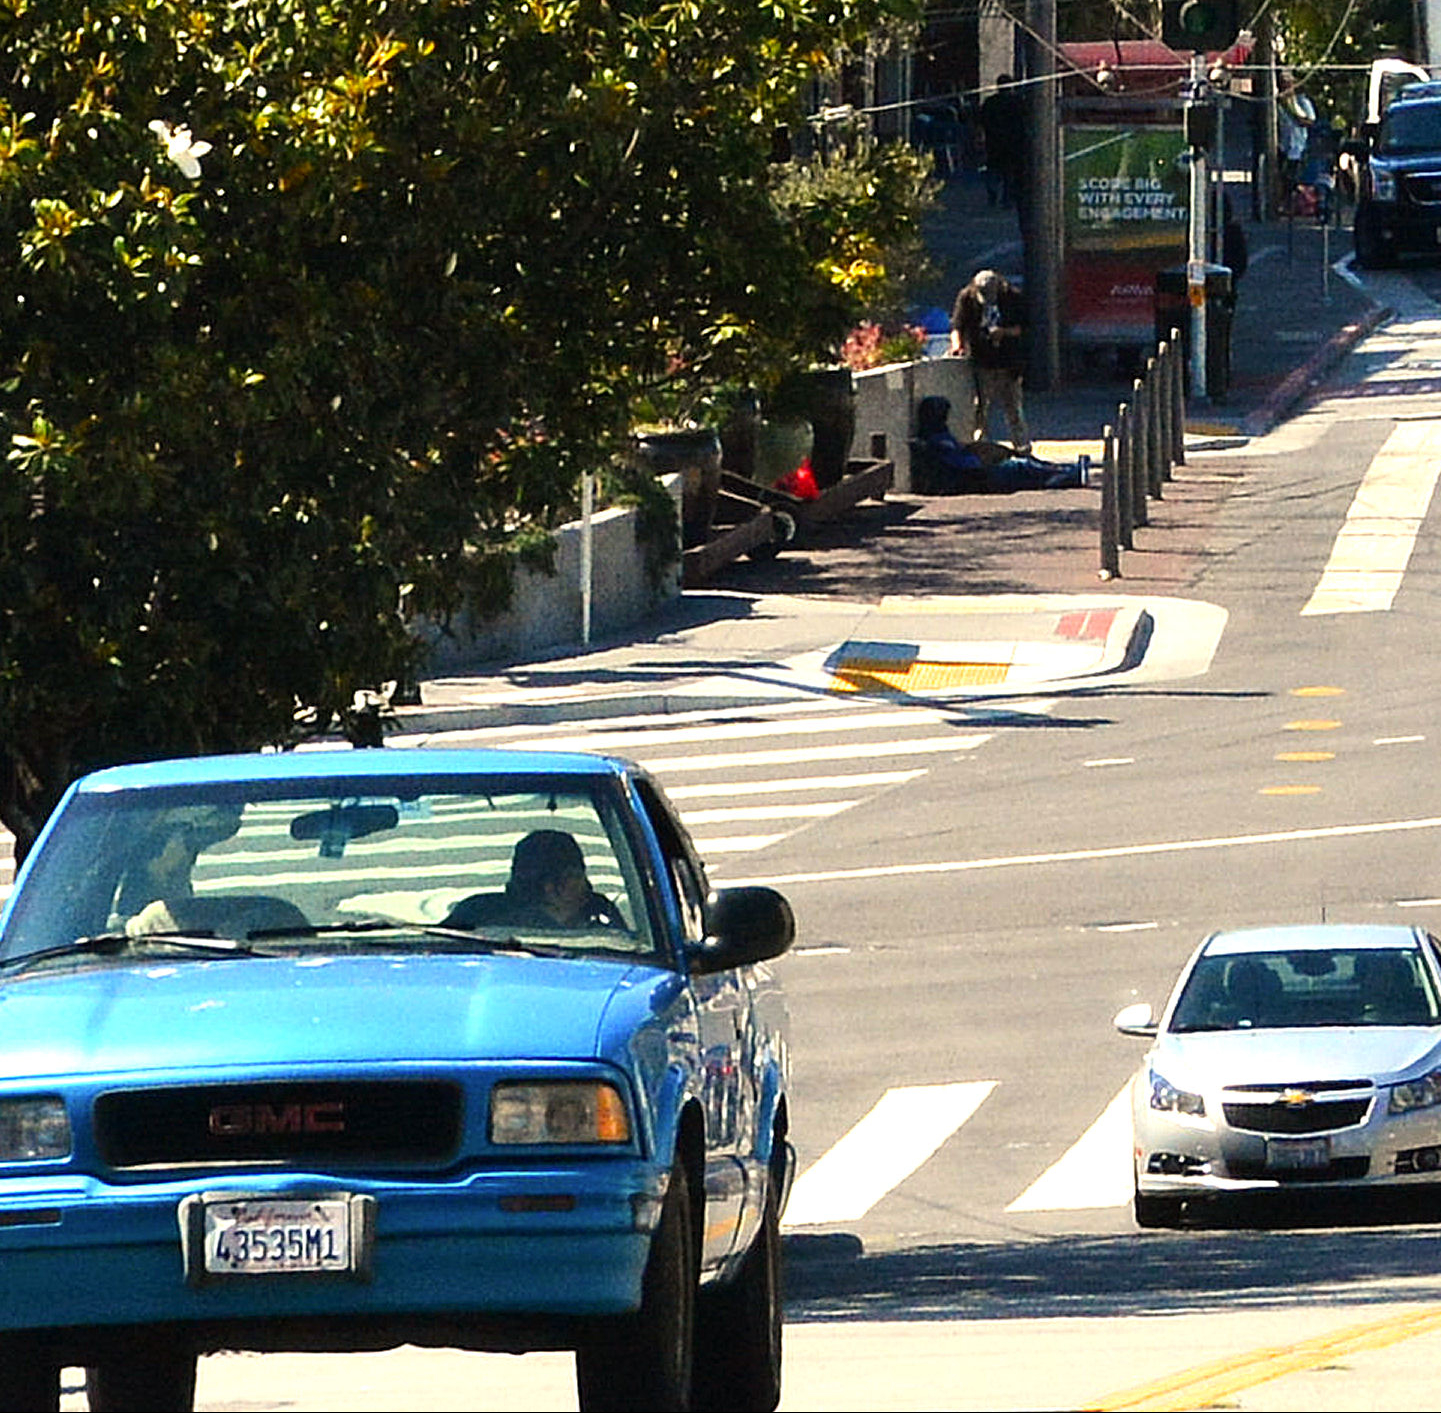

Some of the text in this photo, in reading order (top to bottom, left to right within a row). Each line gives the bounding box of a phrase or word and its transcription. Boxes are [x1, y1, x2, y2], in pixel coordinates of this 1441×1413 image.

[1078, 177, 1162, 191] SCORE BIG
[1077, 192, 1176, 206] WITH EVERY
[208, 1101, 345, 1136] GMC
[216, 1226, 339, 1263] 43535M1
